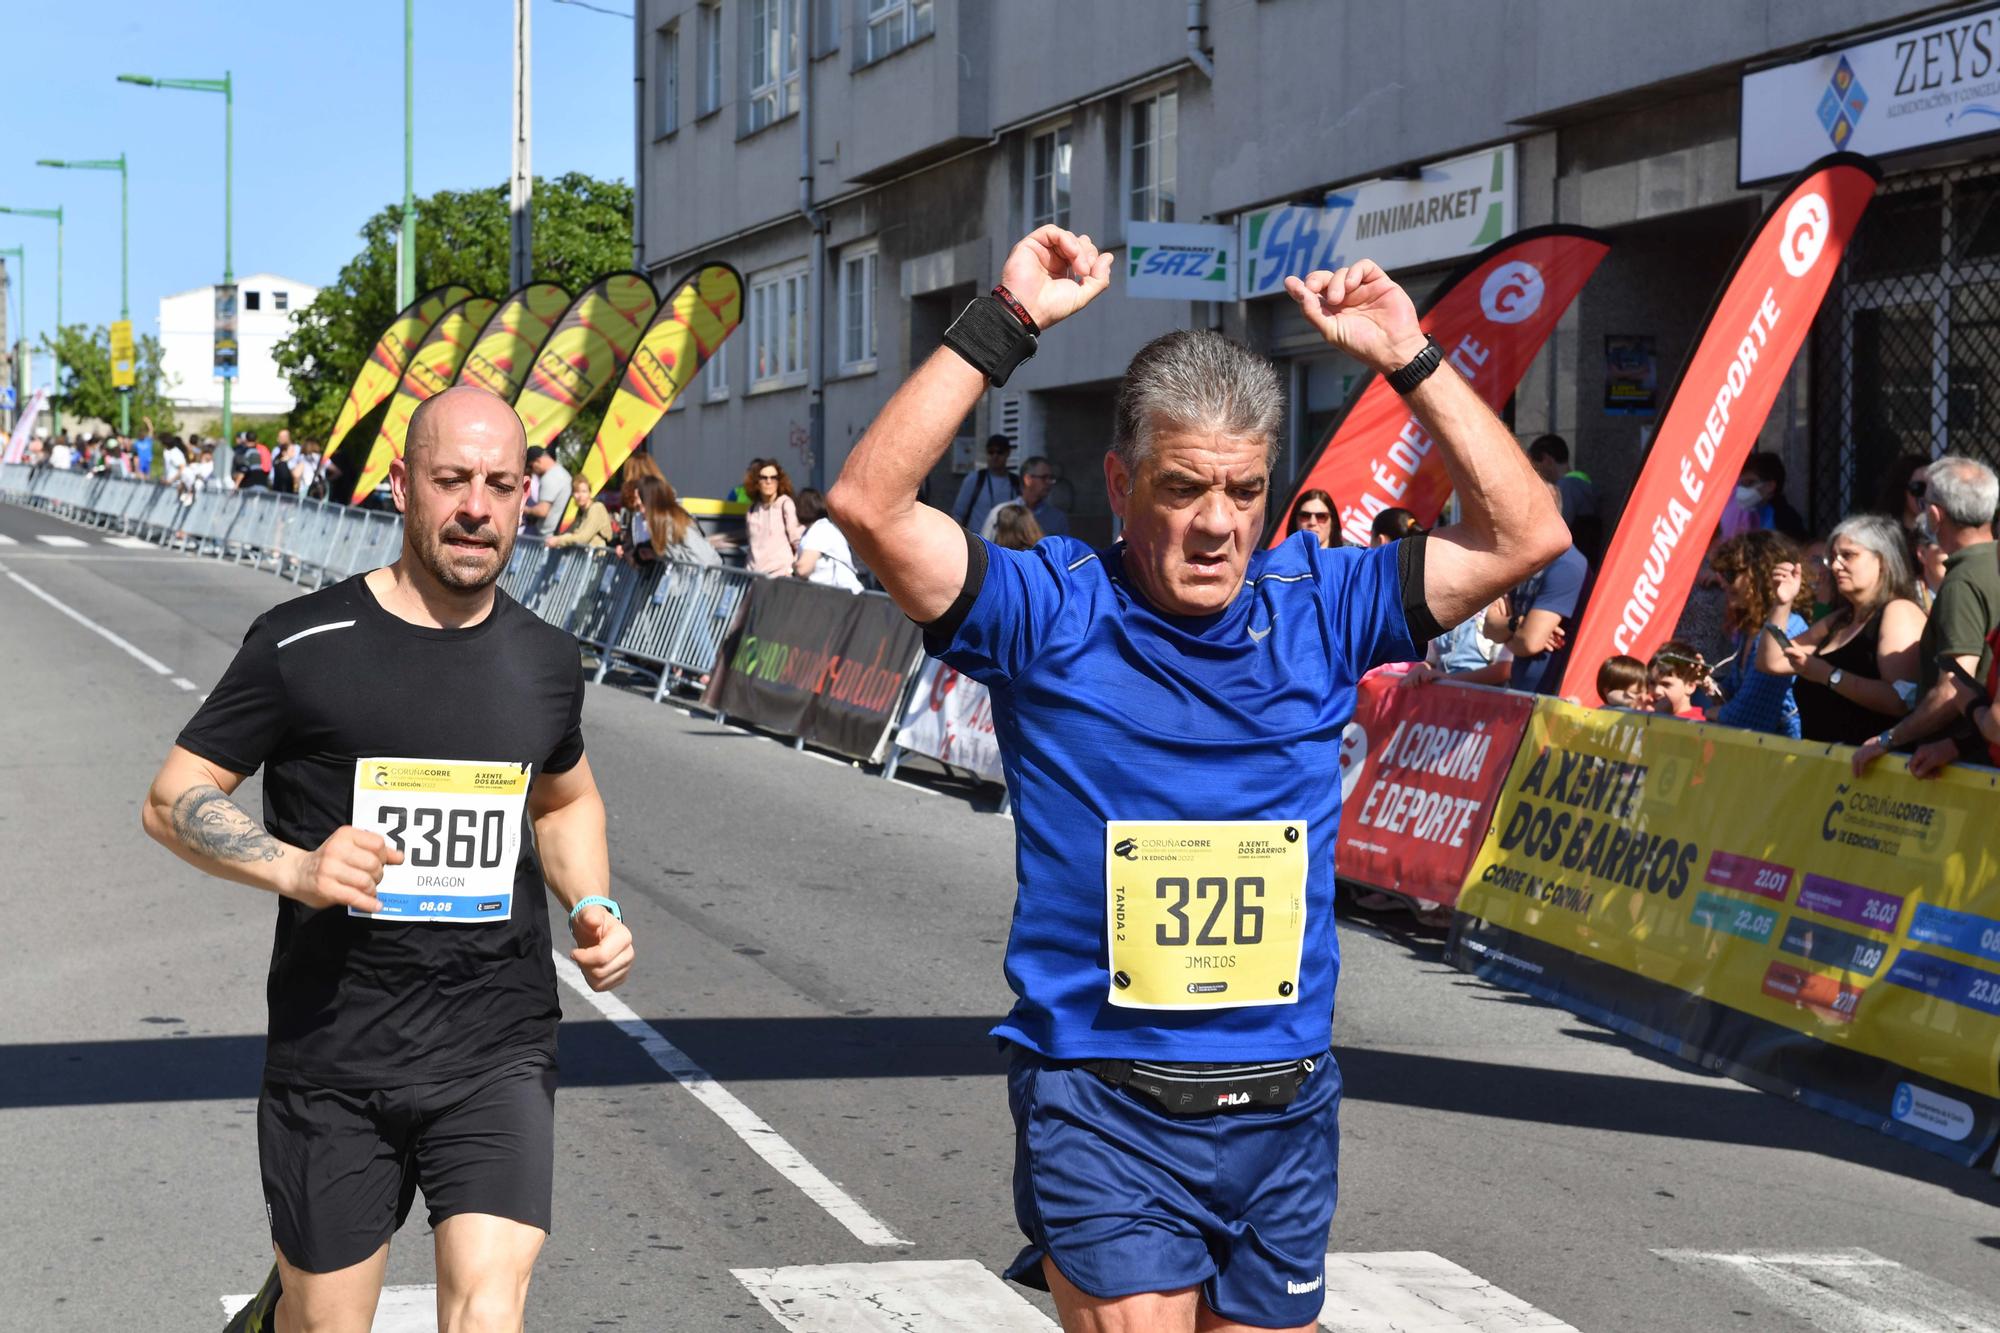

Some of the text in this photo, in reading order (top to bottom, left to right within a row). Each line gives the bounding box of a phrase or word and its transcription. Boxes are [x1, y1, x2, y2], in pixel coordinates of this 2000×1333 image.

[1894, 15, 2000, 96] ZEYS
[1356, 187, 1482, 240] MINIMARKET
[1158, 245, 1216, 253] MINIMARKET
[1259, 189, 1359, 290] SAZ
[1142, 252, 1212, 276] SAZ
[1371, 459, 1407, 500] É
[1613, 287, 1781, 655] CORUÑA É DEPORTE
[1379, 720, 1492, 782] A CORUÑA
[1519, 746, 1648, 818] A XENTE
[1358, 770, 1481, 847] É DEPORTE
[378, 806, 505, 869] 3360
[1142, 838, 1211, 847] CORUÑACORRE
[1499, 801, 1698, 899] DOS BARRIOS
[417, 875, 465, 888] DRAGON
[1481, 864, 1528, 893] CORRE
[419, 901, 452, 912] 08.05
[1116, 886, 1125, 930] TANDA
[1155, 877, 1265, 946] 326
[1733, 909, 1772, 934] 22.05
[1862, 899, 1897, 924] 26.03
[1185, 955, 1236, 969] JMRIOS
[1852, 944, 1881, 968] 11.09
[1217, 1091, 1250, 1106] FILA
